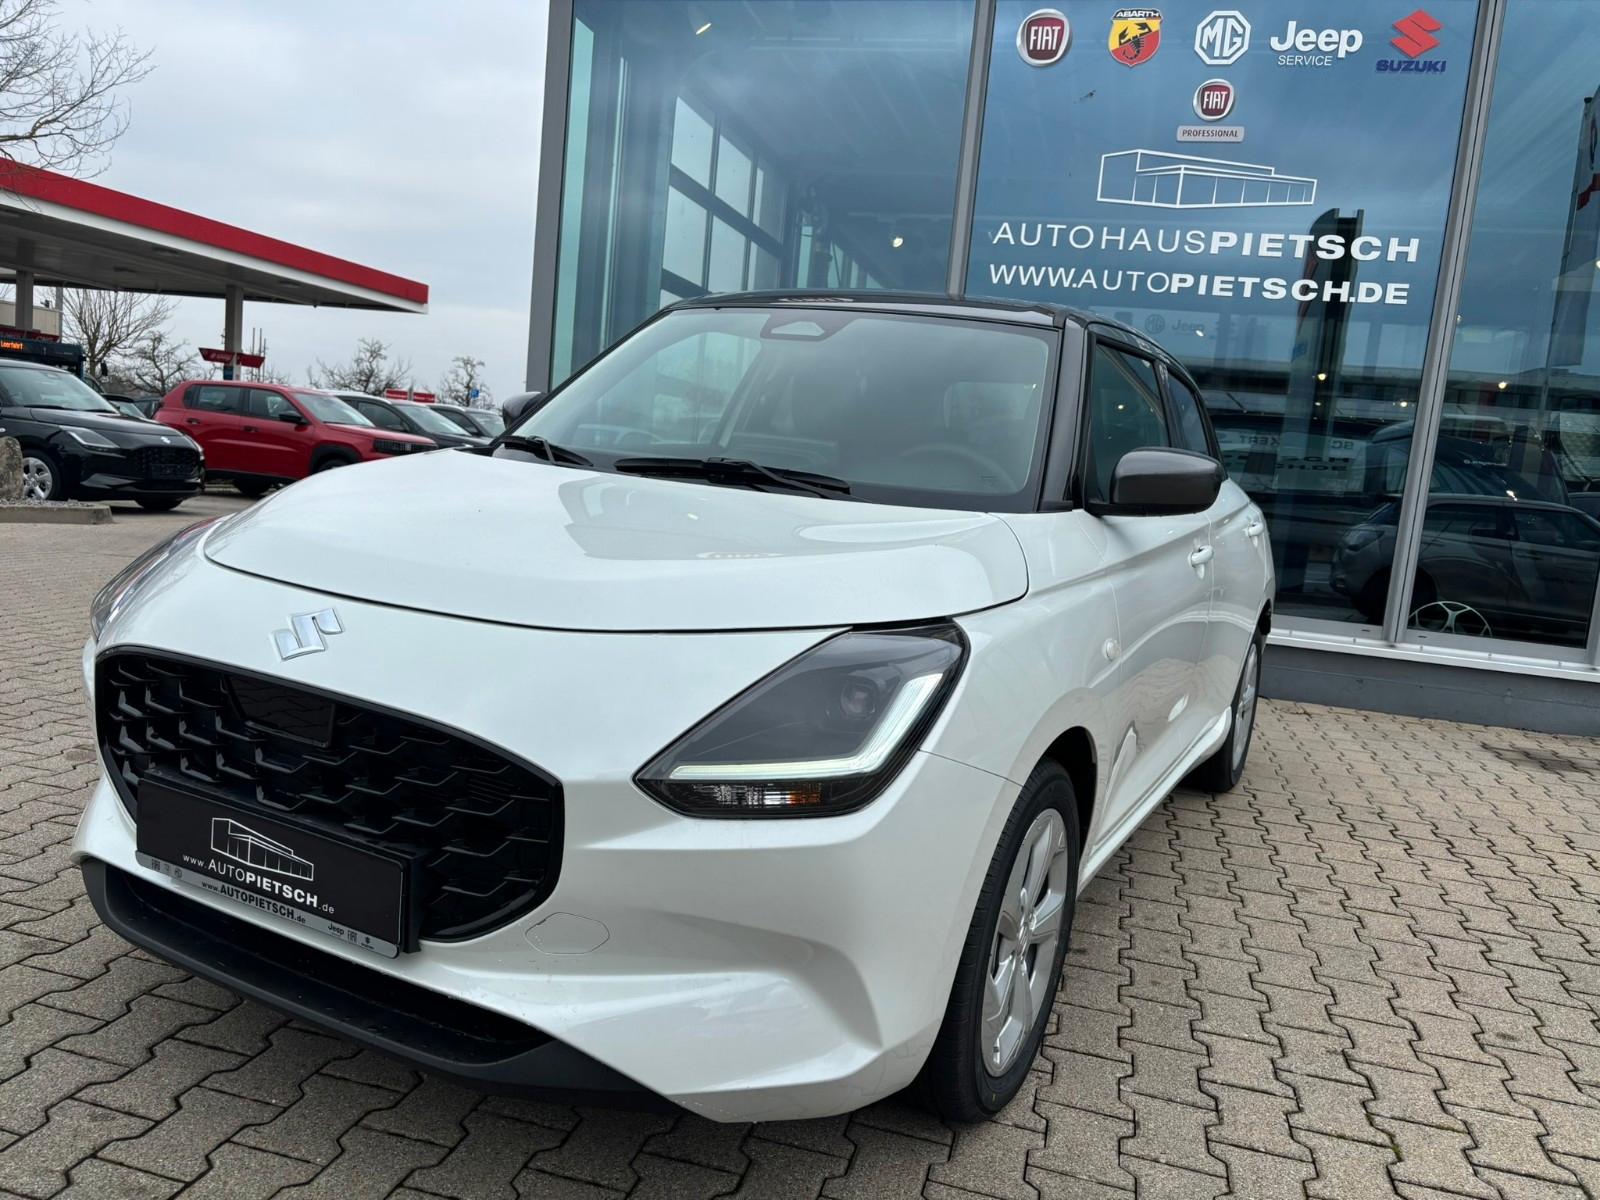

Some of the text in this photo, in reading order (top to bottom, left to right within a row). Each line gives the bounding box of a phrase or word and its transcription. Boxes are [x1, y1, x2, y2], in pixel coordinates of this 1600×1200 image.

[1116, 10, 1159, 18] ABARTH
[1029, 26, 1061, 51] FIAT
[1201, 18, 1244, 57] MG
[1270, 20, 1363, 58] Jeep
[1277, 55, 1333, 66] SERVICE
[1375, 59, 1447, 73] SUZUKI
[1203, 91, 1228, 109] FIAT
[1182, 129, 1239, 137] PROFESSIONAL
[989, 264, 1410, 305] WWW.AUTOPIETSCH.DE
